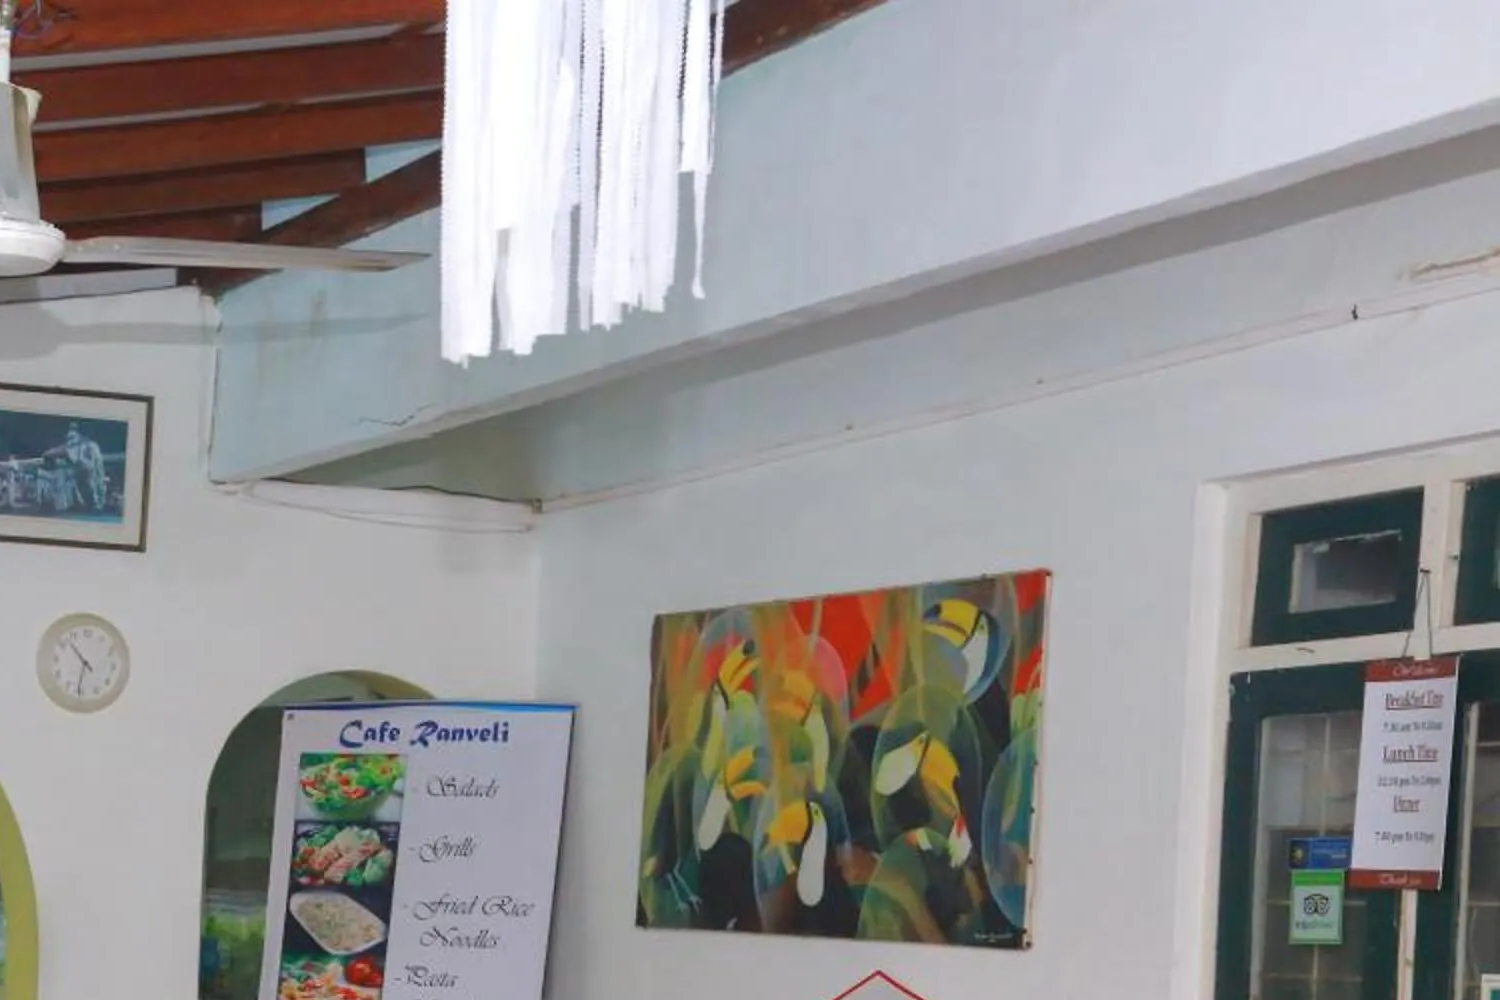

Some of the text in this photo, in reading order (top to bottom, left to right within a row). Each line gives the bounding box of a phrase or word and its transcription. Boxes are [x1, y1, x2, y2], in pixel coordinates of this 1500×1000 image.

[339, 720, 510, 748] Cafe Ranveli
[425, 774, 500, 798] Salads
[413, 893, 535, 920] Fried Rice
[420, 928, 500, 951] Noodles
